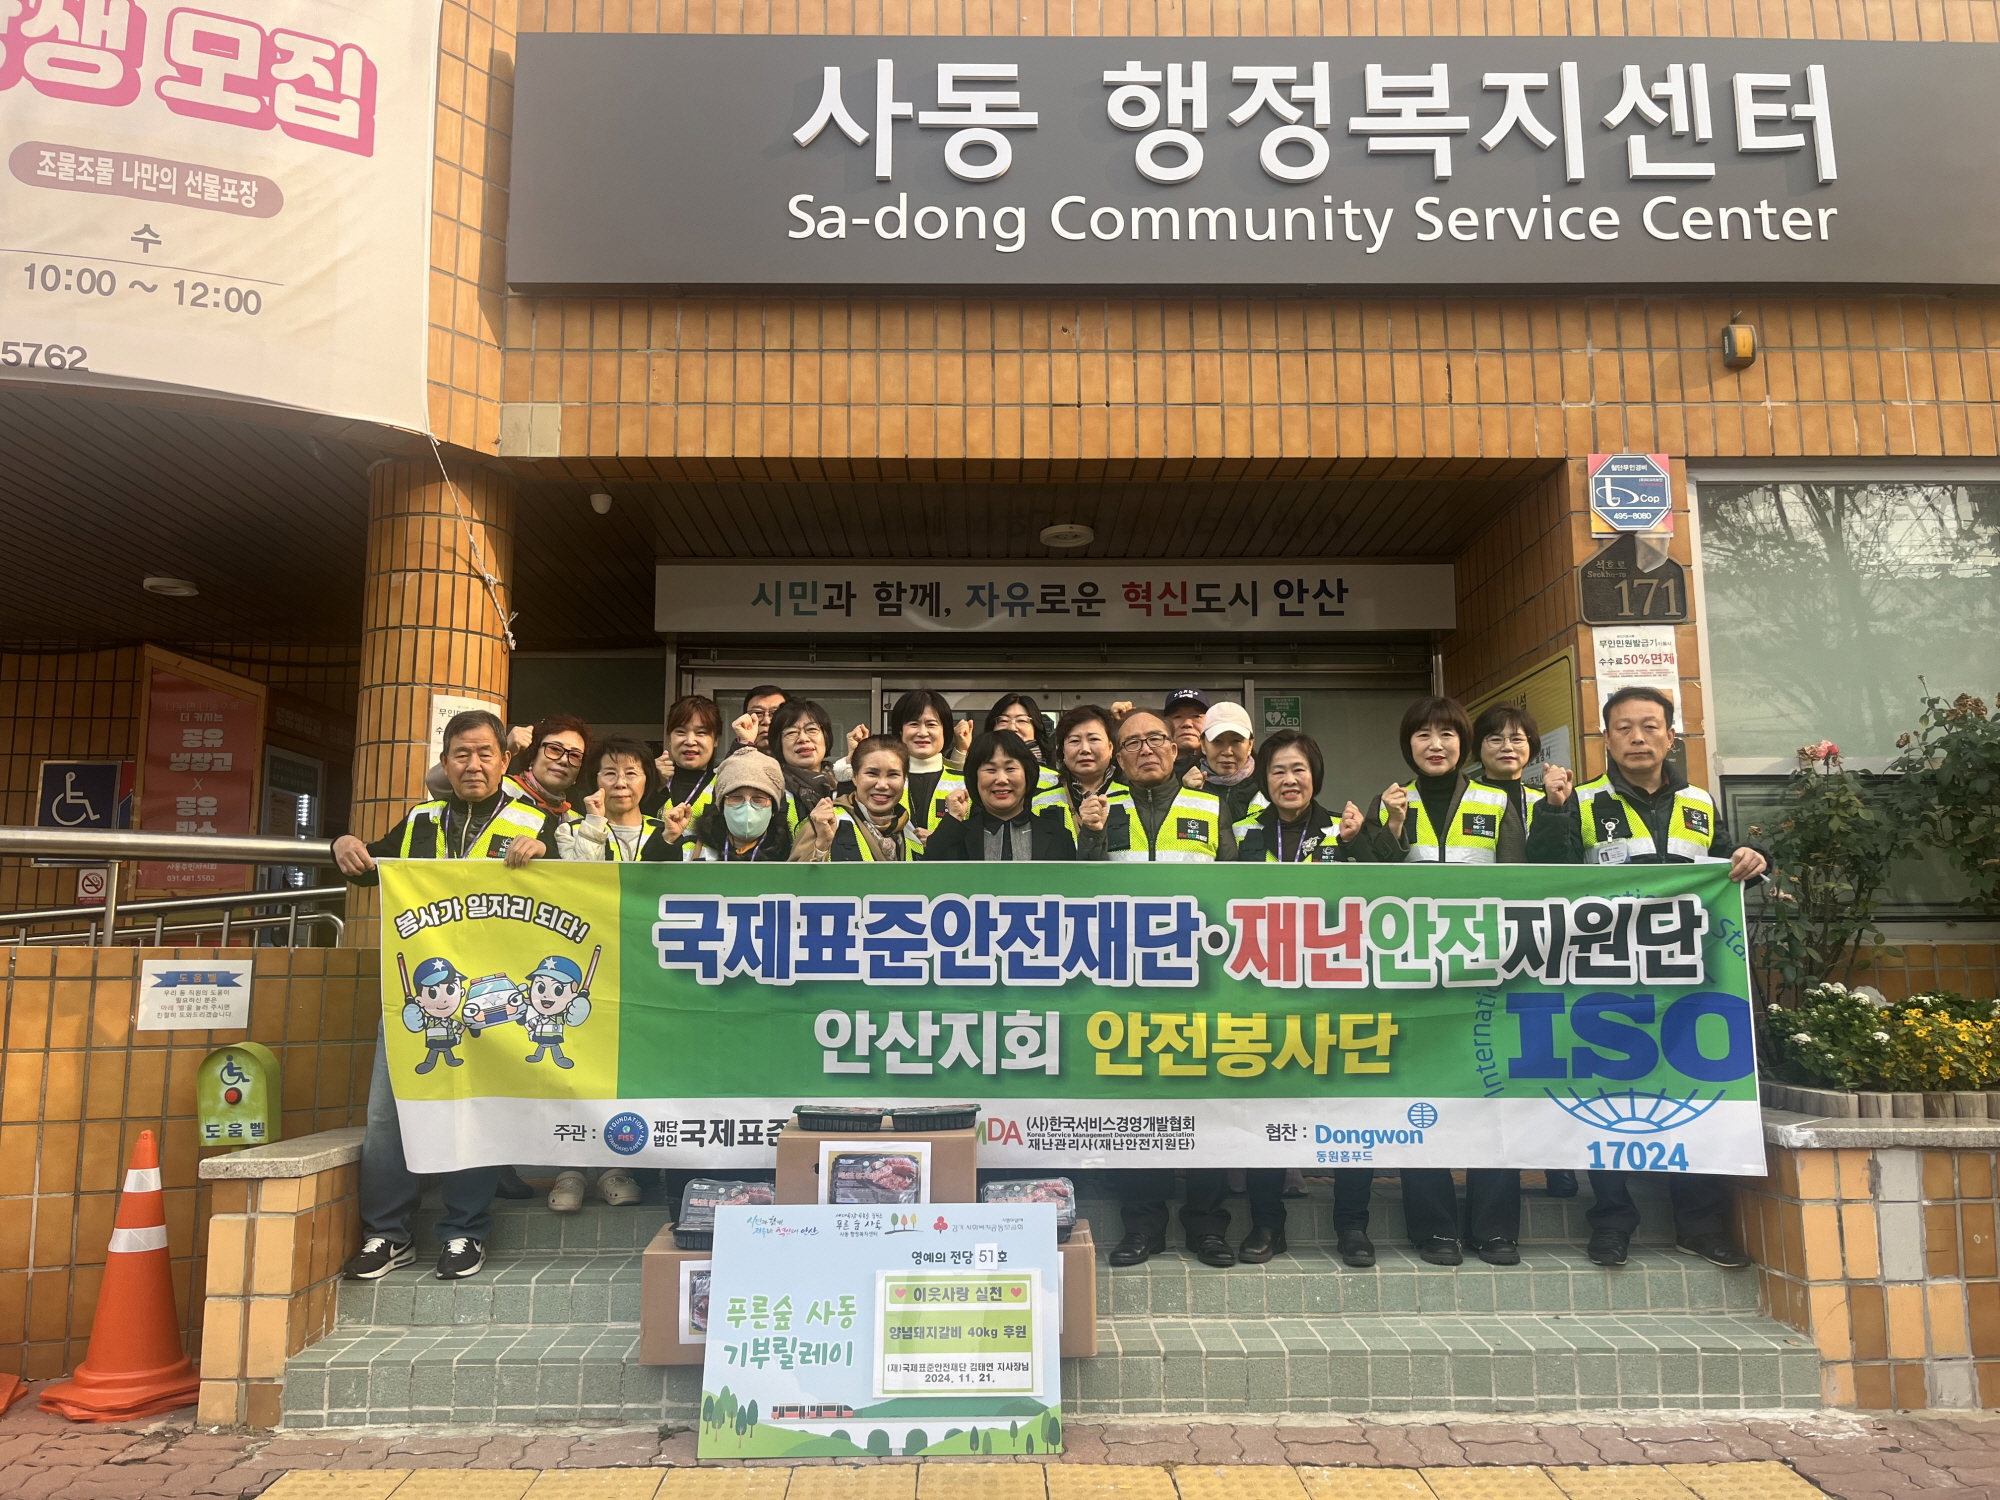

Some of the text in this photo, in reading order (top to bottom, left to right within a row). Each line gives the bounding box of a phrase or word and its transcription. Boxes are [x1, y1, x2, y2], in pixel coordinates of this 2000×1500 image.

[155, 6, 377, 158] 모집
[793, 58, 1838, 184] 사동 행정복지센터
[36, 150, 258, 208] 조물조물 나만의 선물포장
[787, 192, 1838, 254] Sa-dong Community Service Center
[131, 223, 163, 254] 수
[24, 262, 117, 297] 10:00
[174, 279, 262, 315] 12:00
[1613, 512, 1652, 520] 495-8080
[1595, 560, 1627, 571] 석호로
[750, 578, 1349, 619] 시민과 함께, 자유로운 혁신도시 안산
[1614, 578, 1682, 616] 171
[180, 712, 223, 722] 더 커지는
[1279, 717, 1299, 726] AED
[182, 728, 224, 748] 공유
[169, 752, 233, 771] 냉장고
[176, 796, 218, 816] 공유
[395, 893, 590, 943] 봉사가 일자리 되다!
[164, 989, 177, 997] 우리
[188, 989, 208, 997] 직원의
[210, 989, 230, 997] 도움이
[813, 1009, 1400, 1077] 안산지회 안전봉사단
[1505, 991, 1755, 1083] ISO
[608, 1115, 645, 1131] FOUNDATION
[653, 1120, 679, 1133] 재단
[1026, 1116, 1195, 1132] (사)한국서비스경영개발협회
[1265, 1123, 1298, 1142] 협찬
[553, 1124, 587, 1142] 주관
[617, 1134, 635, 1142] FISS
[653, 1135, 678, 1147] 법인
[1315, 1125, 1424, 1149] Dongwon
[1028, 1138, 1195, 1151] 재난관리사(재난안전지원단)
[1316, 1150, 1373, 1163] 동원홈푸드
[1586, 1140, 1690, 1171] 17024
[911, 1250, 946, 1265] 영예의
[950, 1250, 973, 1265] 전당
[913, 1287, 1002, 1302] 이웃사랑 실천
[724, 1294, 858, 1332] 푸른숲 사동
[889, 1325, 1027, 1340] 양념돼지갈비 40kg 후원
[723, 1336, 854, 1370] 기부릴레이
[887, 1361, 1029, 1373] (재)국제표준안전재단 김태연 지사장님
[925, 1373, 995, 1383] 2024. 11. 21.
